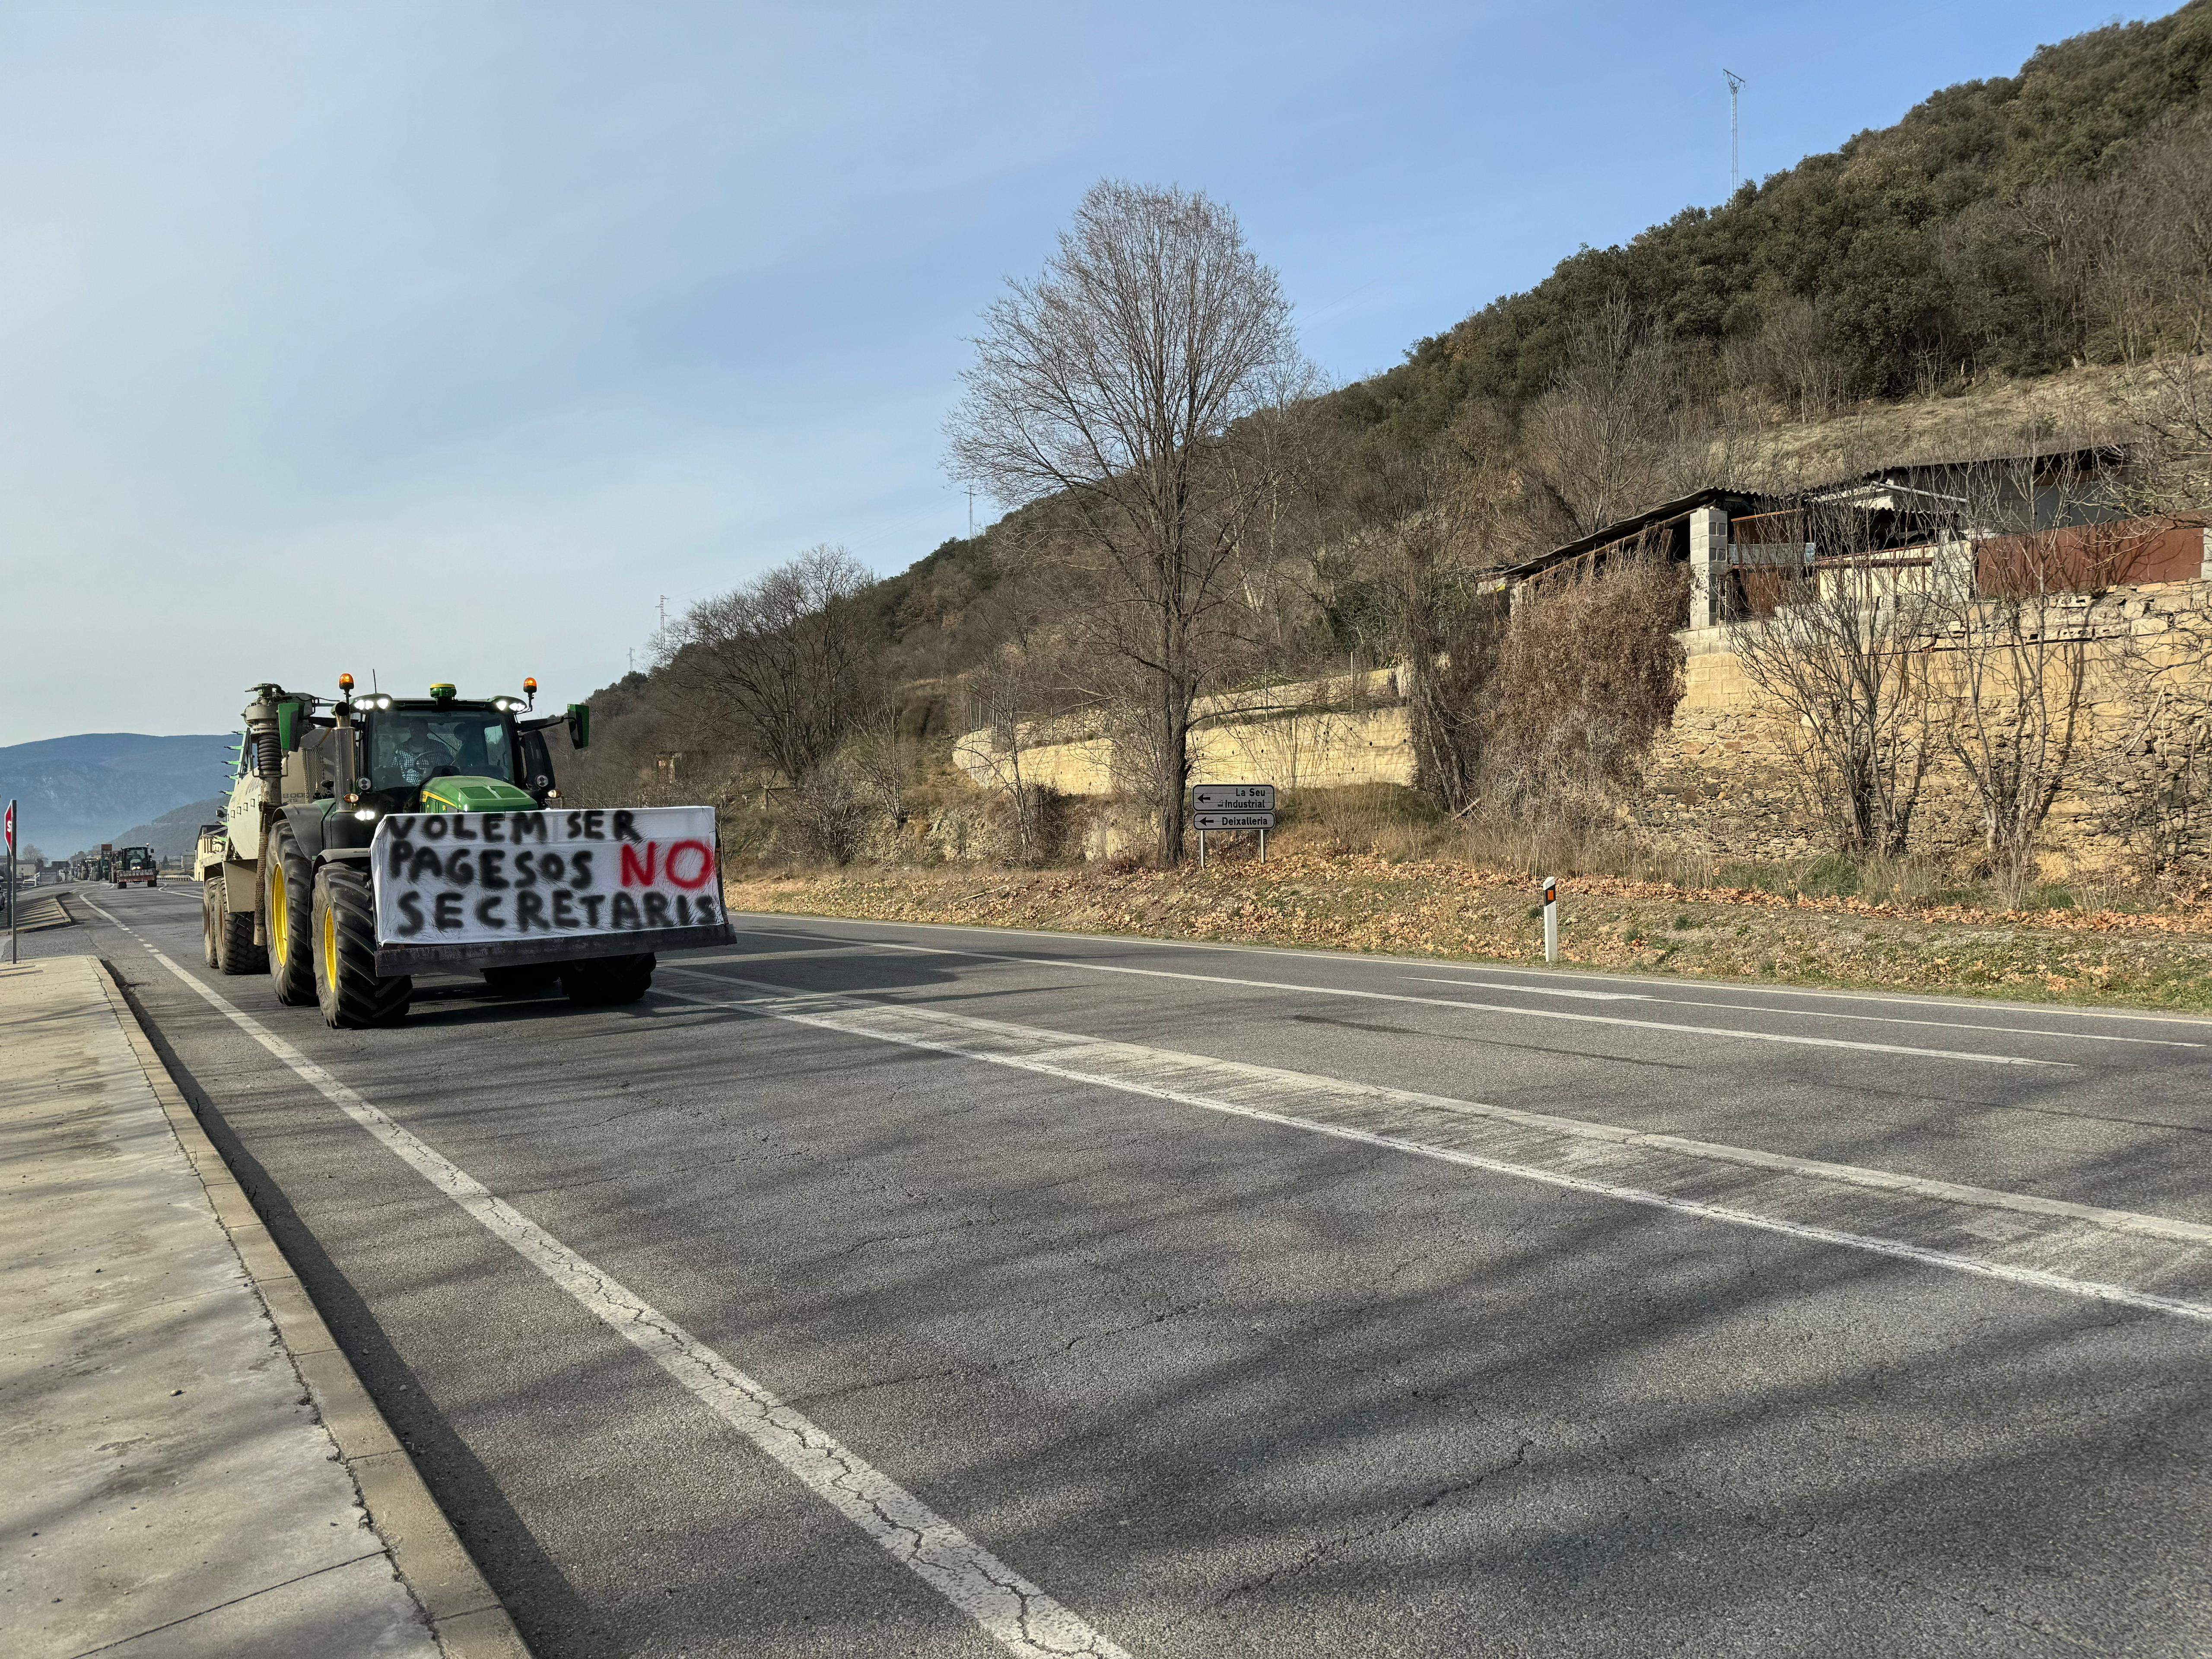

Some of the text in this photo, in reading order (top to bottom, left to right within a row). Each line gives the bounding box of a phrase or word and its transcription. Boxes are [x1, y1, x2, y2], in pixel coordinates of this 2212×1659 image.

[1225, 799, 1265, 808] Industrial
[1236, 788, 1265, 797] La Seu
[388, 810, 643, 845] VOLEM SER
[1222, 816, 1268, 826] Deixalleria
[390, 839, 714, 890] PAGESOS NO
[396, 890, 717, 937] SECRETARIS
